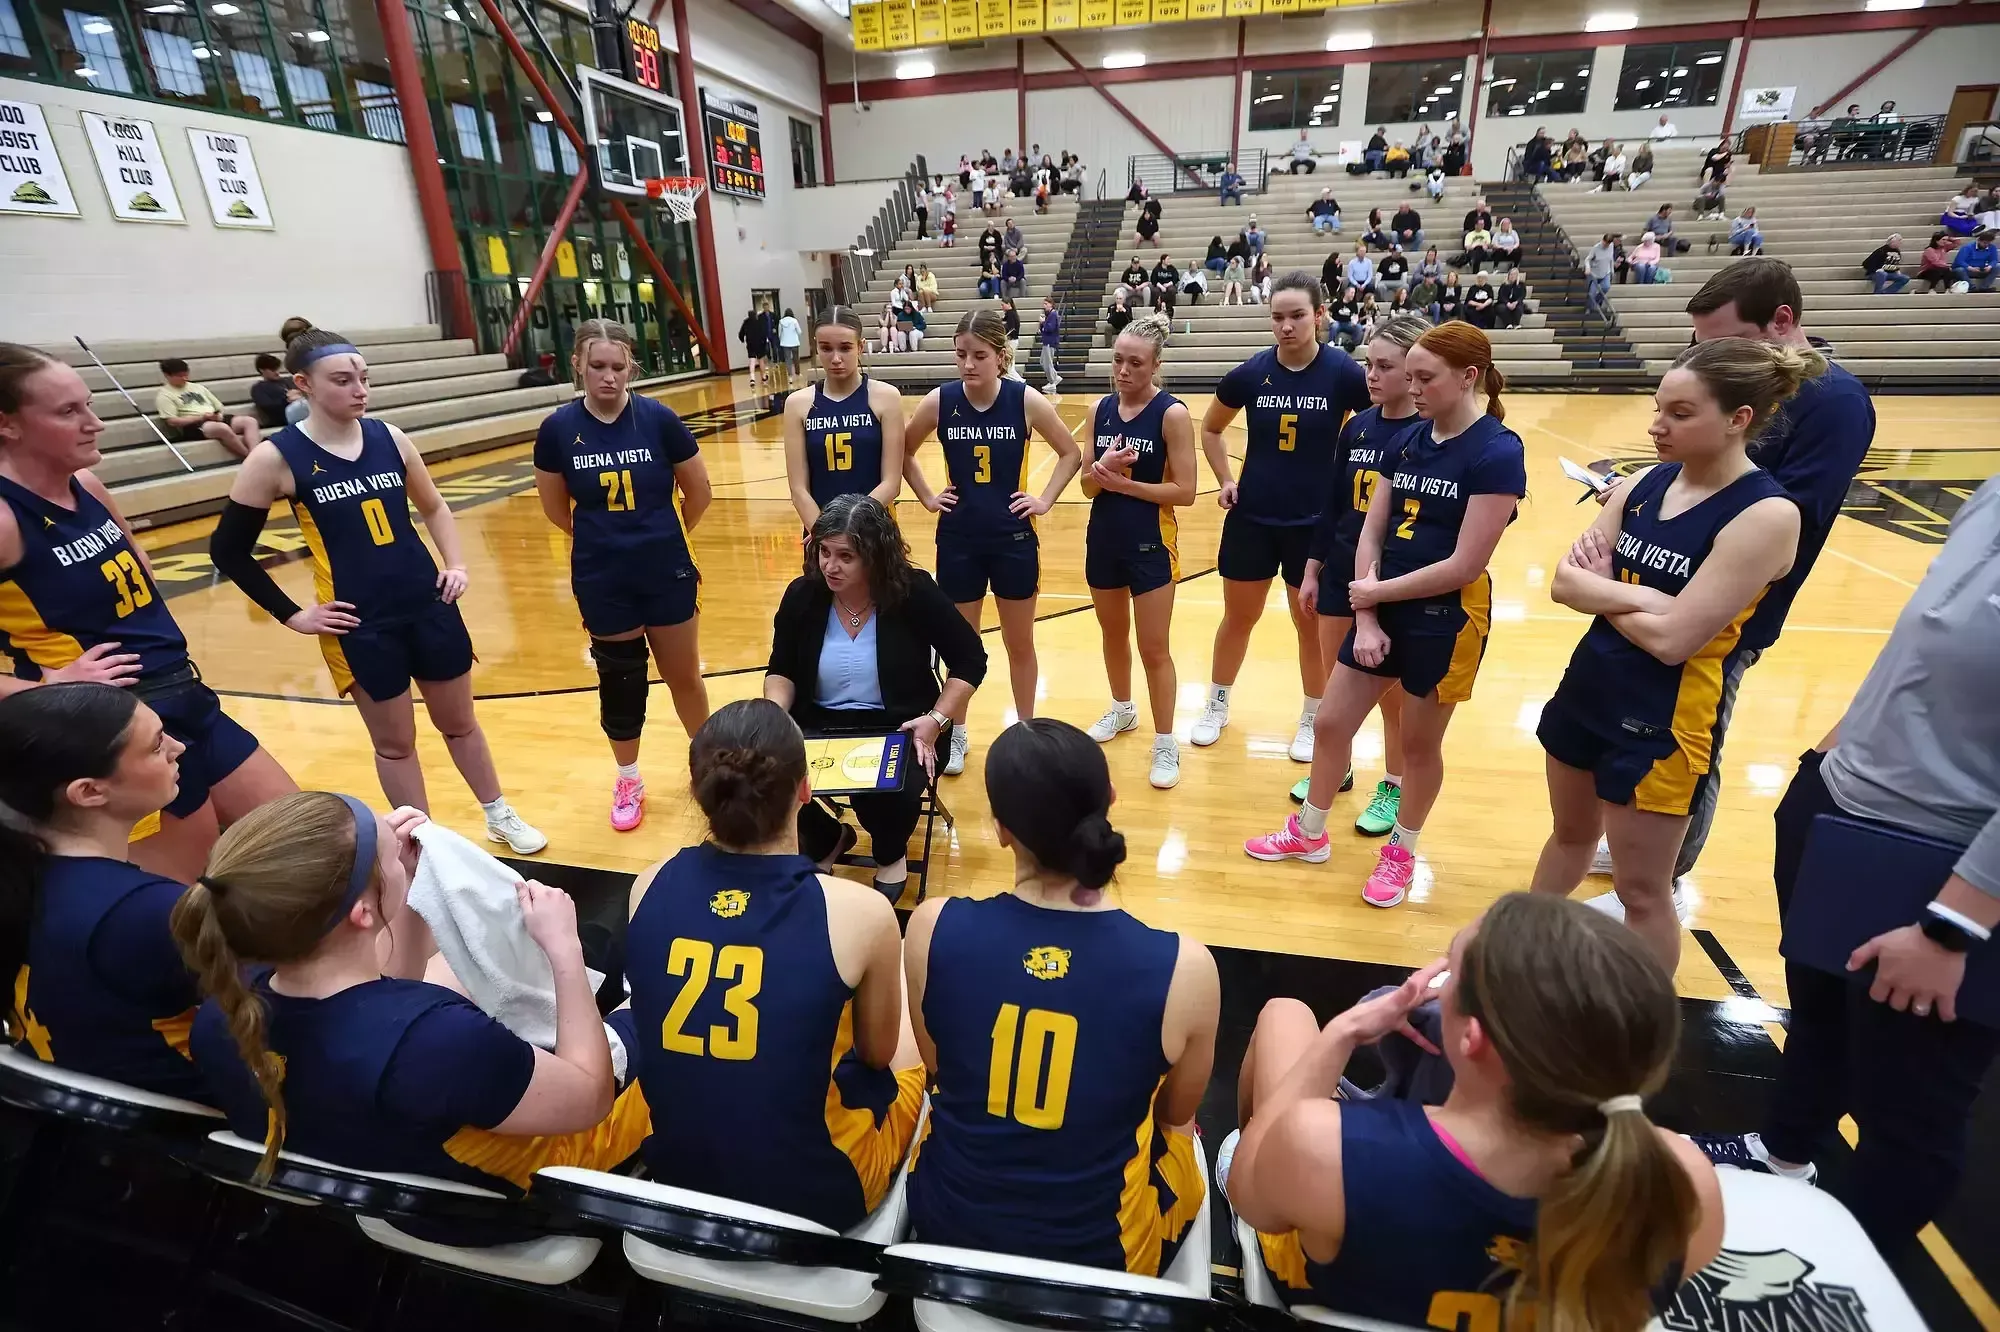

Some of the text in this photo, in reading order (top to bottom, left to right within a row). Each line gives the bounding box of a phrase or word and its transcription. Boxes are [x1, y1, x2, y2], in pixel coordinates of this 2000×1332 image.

[628, 20, 658, 51] 10:00
[633, 45, 659, 89] 30
[0, 154, 41, 175] CLUB
[115, 144, 146, 163] KILL
[119, 167, 153, 186] CLUB
[218, 178, 248, 194] CLUB
[1256, 395, 1328, 411] BUENA VISTA
[805, 413, 873, 431] BUENA VISTA
[947, 426, 1016, 440] BUENA VISTA
[1278, 413, 1298, 451] 5
[573, 448, 652, 470] BUENA VISTA
[825, 432, 852, 471] 15
[974, 446, 991, 483] 3
[313, 478, 368, 503] BUENA
[366, 471, 404, 491] VISTA
[599, 469, 636, 511] 21
[1353, 468, 1380, 513] 13
[1420, 476, 1459, 500] VISTA
[361, 498, 394, 546] 0
[1396, 498, 1420, 540] 2
[52, 518, 125, 567] BUENA VISTA
[1640, 543, 1691, 578] VISTA
[101, 550, 152, 619] 33
[661, 937, 764, 1061] 23
[987, 1002, 1079, 1130] 10
